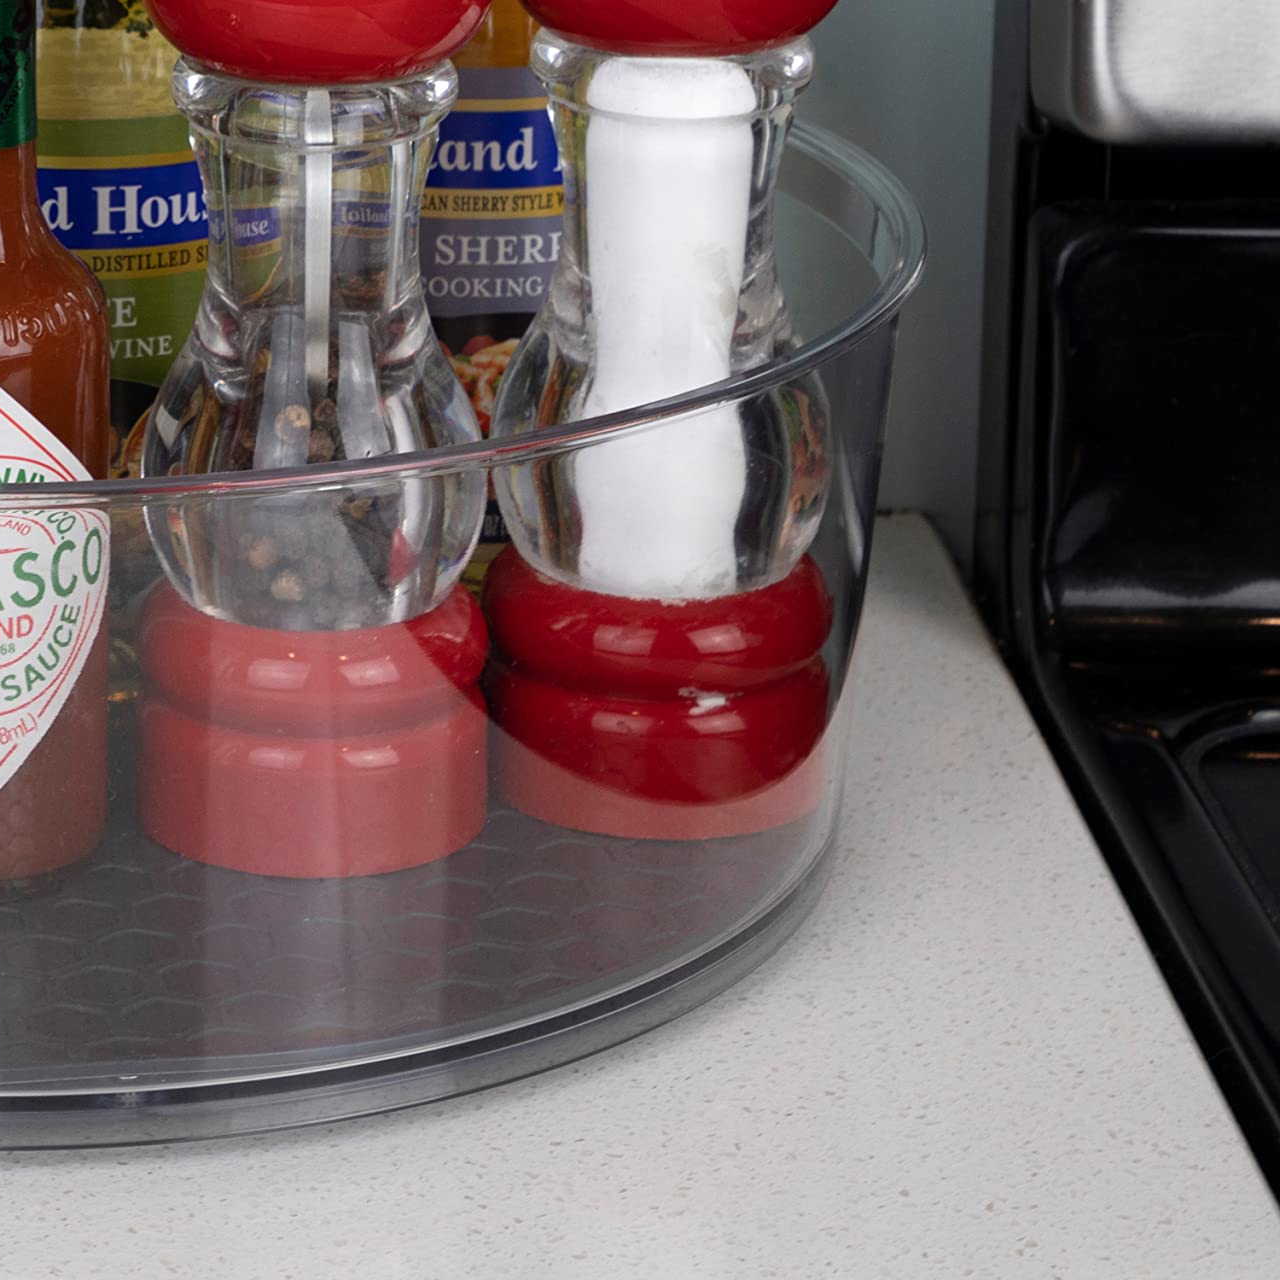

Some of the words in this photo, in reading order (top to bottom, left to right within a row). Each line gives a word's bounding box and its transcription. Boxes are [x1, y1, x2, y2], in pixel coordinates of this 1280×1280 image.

[453, 196, 509, 212] SHERRY
[512, 193, 554, 210] STYLE
[92, 249, 191, 273] DISTILLED
[421, 276, 544, 298] OOKING
[0, 602, 81, 702] SAUCE
